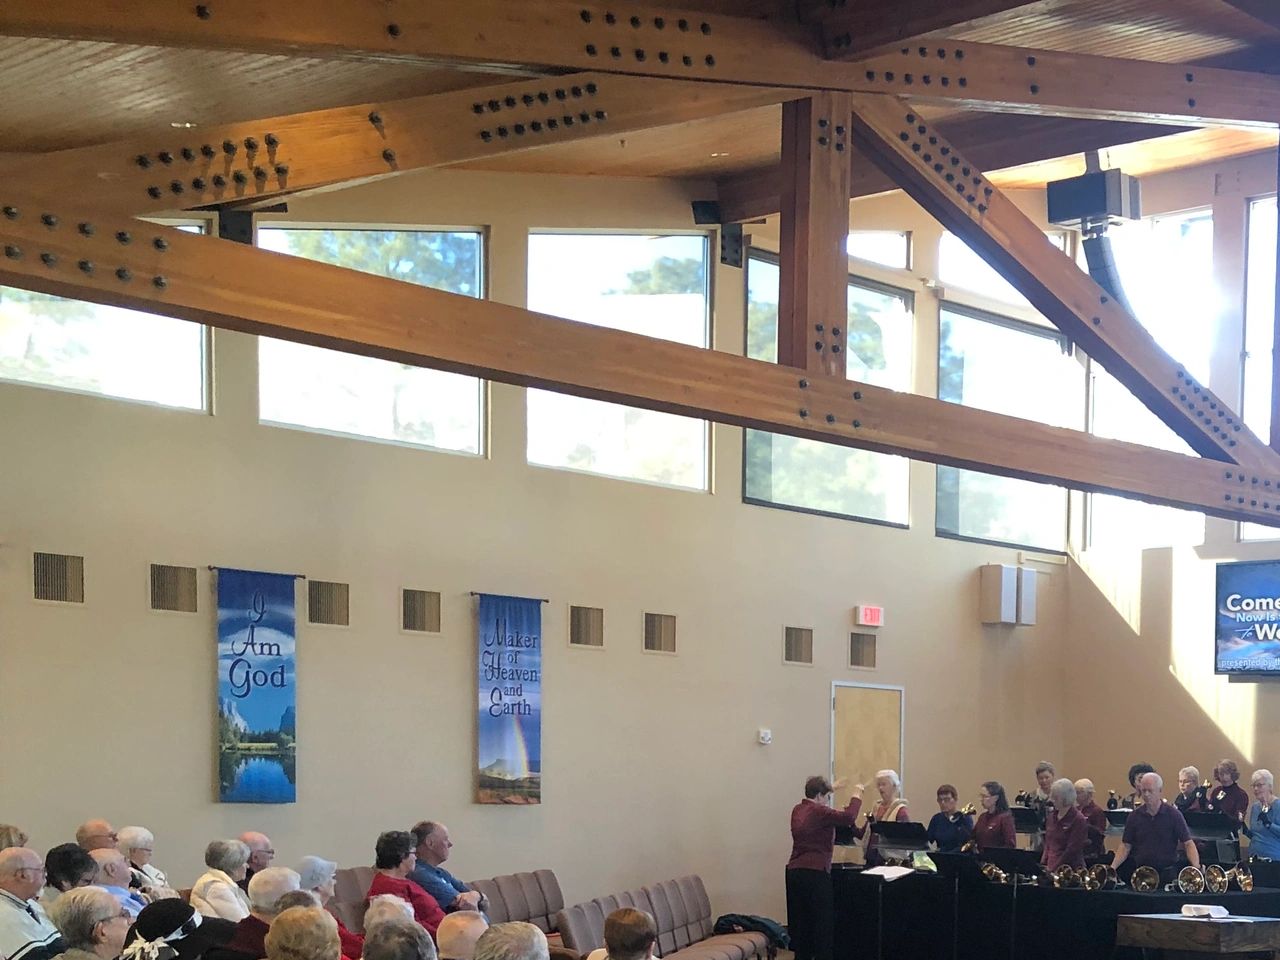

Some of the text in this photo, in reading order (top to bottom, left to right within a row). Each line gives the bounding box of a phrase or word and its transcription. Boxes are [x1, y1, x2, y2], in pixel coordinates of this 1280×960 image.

[248, 590, 267, 623] I
[1236, 612, 1265, 622] Now
[1266, 612, 1275, 622] Is
[232, 624, 282, 657] Am
[484, 618, 538, 648] Maker
[482, 651, 538, 681] Heaven
[507, 650, 520, 664] of
[1221, 658, 1260, 668] presented
[229, 658, 287, 698] God
[503, 684, 522, 697] and
[489, 687, 532, 717] Earth
